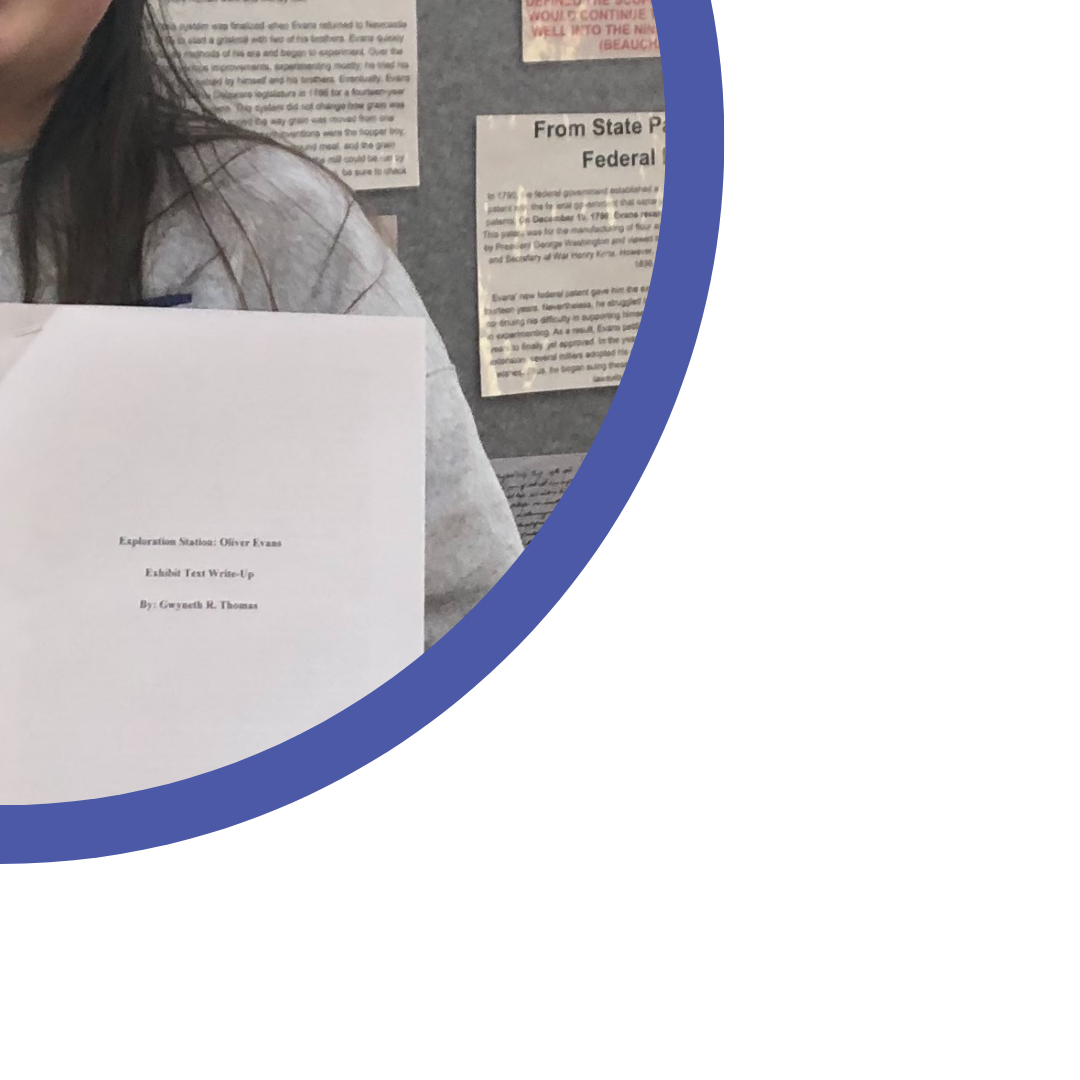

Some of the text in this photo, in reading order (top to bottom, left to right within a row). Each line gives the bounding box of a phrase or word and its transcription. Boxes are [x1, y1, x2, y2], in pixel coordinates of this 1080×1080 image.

[529, 9, 645, 22] WOULD CONTINUE
[532, 26, 565, 36] WELL
[572, 25, 601, 35] INTO
[605, 25, 629, 35] THE
[599, 39, 659, 51] (BEAUCH
[534, 121, 585, 138] From
[593, 118, 642, 136] State
[582, 148, 655, 168] Federal
[119, 536, 282, 547] Exploration Station: Oliver Evans
[145, 568, 254, 580] Exhibit Text Write-Up
[140, 600, 258, 611] By: Gwyneth R. Thomas
